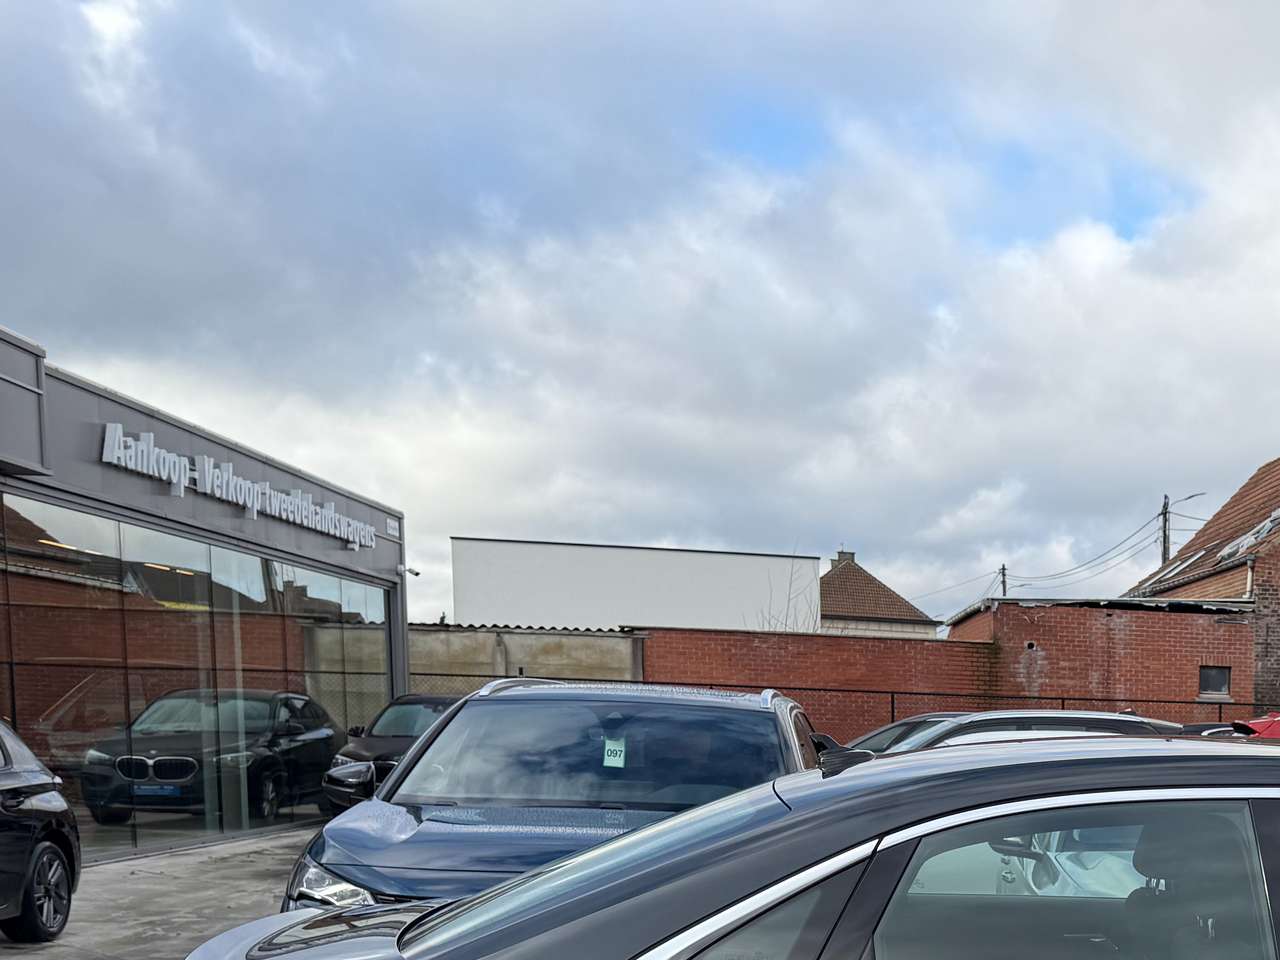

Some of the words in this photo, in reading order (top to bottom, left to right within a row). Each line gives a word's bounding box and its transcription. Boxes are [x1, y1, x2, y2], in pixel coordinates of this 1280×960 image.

[102, 423, 190, 498] Aankoop
[195, 454, 262, 520] Verkoop
[262, 481, 376, 552] tweedehandswagens
[606, 749, 623, 758] 097
